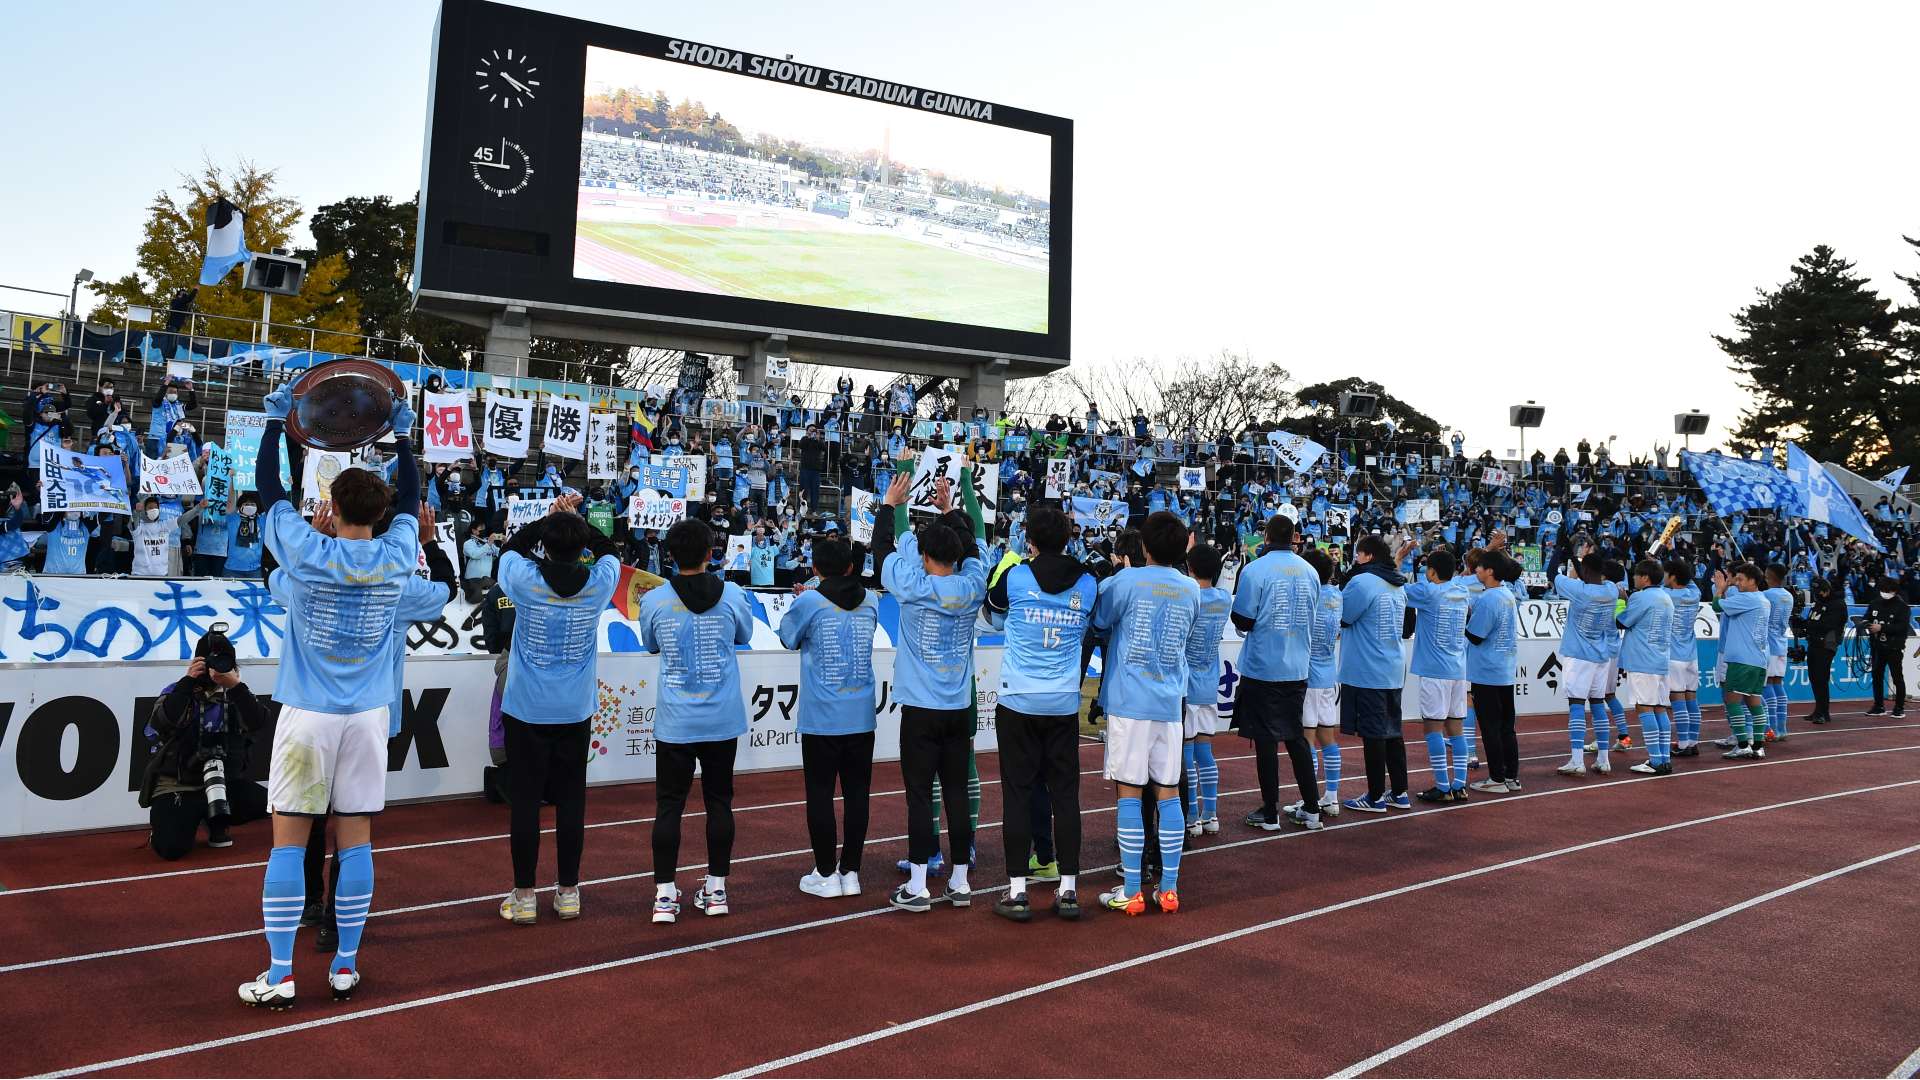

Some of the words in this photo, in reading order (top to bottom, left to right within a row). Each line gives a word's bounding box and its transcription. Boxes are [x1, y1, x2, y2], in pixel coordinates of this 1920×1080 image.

[665, 40, 743, 72] SHODA
[747, 57, 821, 86] SHOYU
[826, 72, 917, 106] STADIUM
[921, 91, 992, 120] GUNMA
[474, 146, 493, 161] 45
[591, 387, 617, 399] 1994
[425, 404, 469, 448] 祝
[488, 402, 524, 442] 優
[548, 404, 581, 442] 勝
[589, 417, 600, 475] ヤット様
[605, 423, 617, 472] 神様仏様
[44, 449, 67, 509] 山田大記
[0, 580, 286, 661] ちの未来
[1024, 608, 1080, 626] YAMAHA
[1043, 626, 1061, 649] 15
